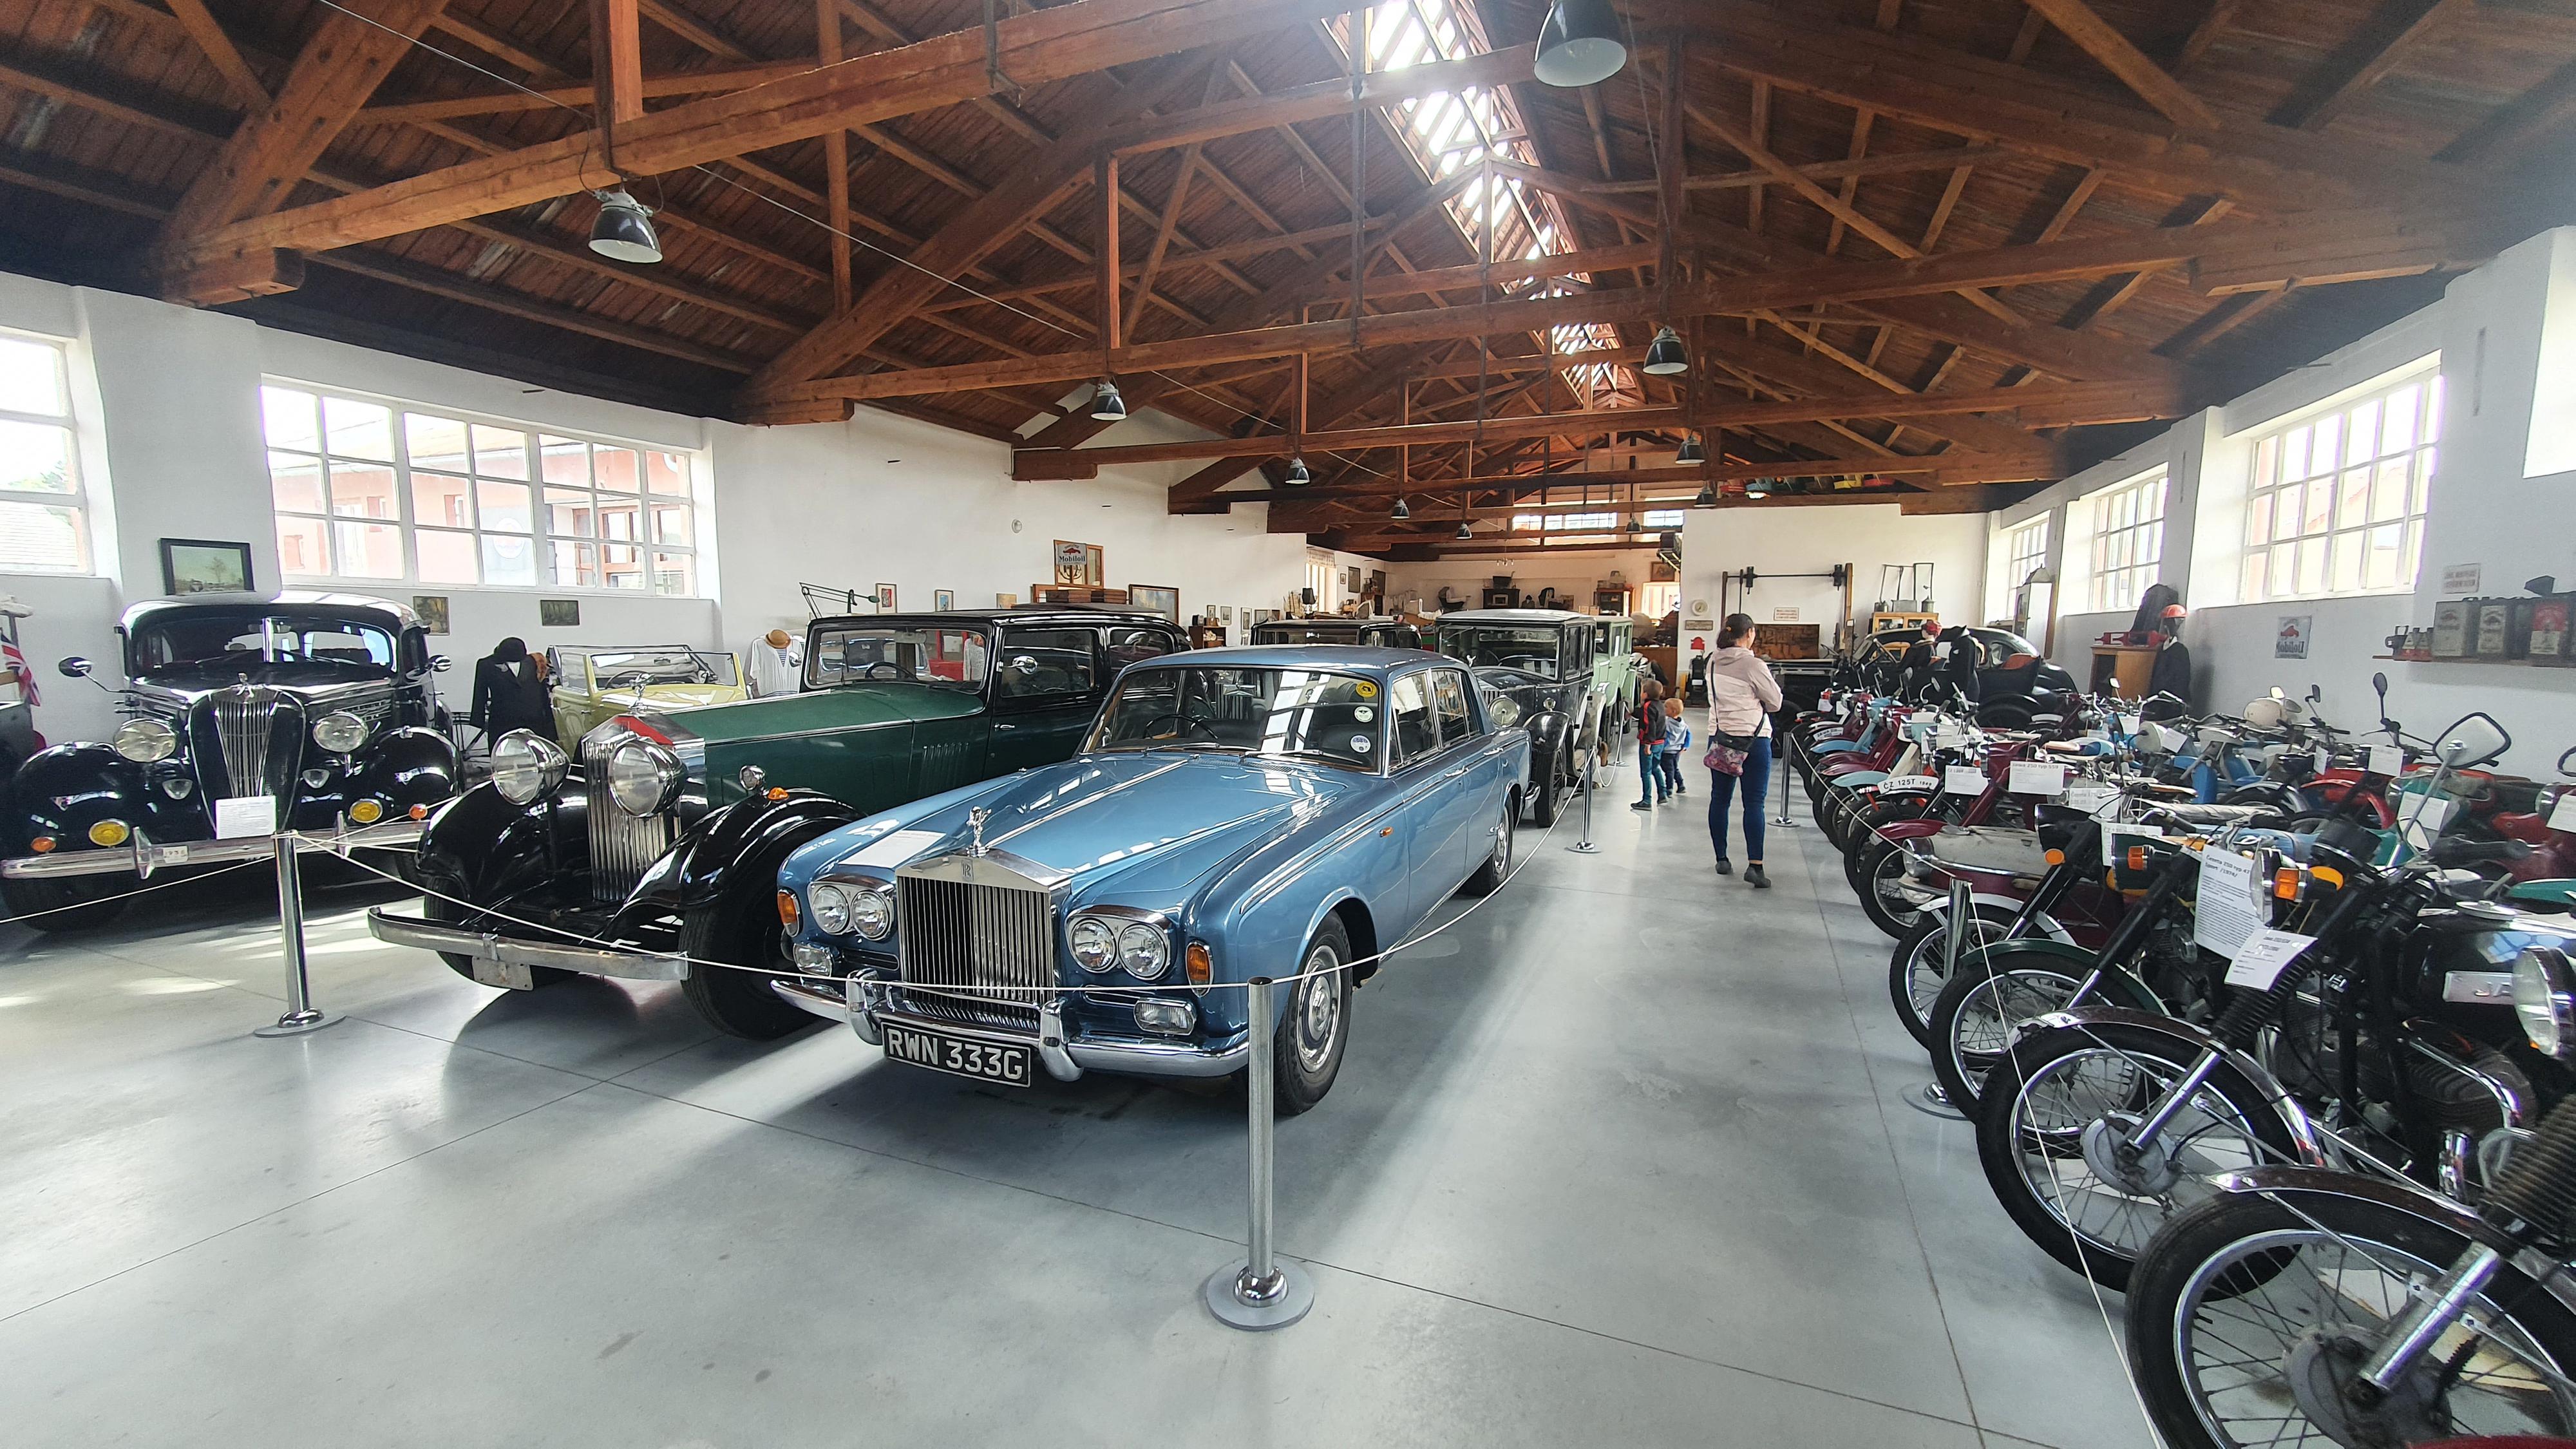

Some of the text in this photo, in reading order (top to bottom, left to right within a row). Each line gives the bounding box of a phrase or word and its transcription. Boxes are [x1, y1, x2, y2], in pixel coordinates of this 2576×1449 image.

[1884, 781, 1894, 790] ČZ
[887, 1028, 1023, 1080] RWN 333G
